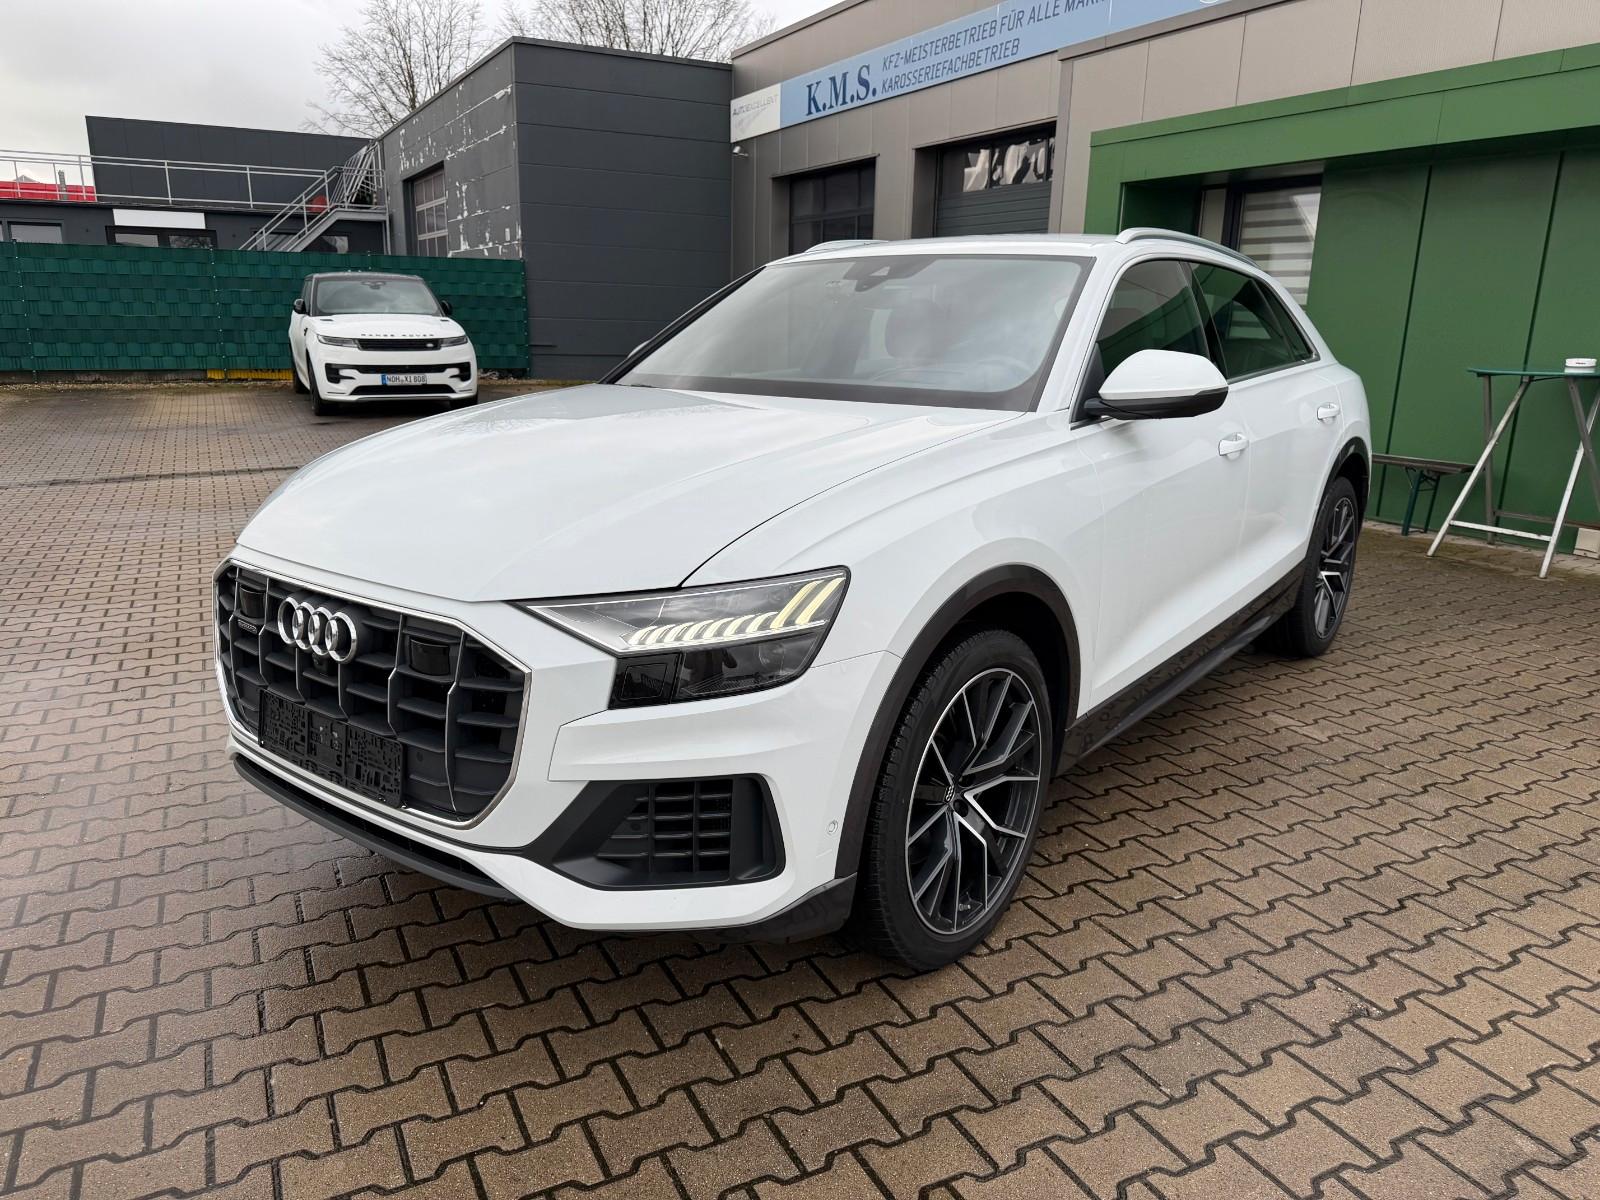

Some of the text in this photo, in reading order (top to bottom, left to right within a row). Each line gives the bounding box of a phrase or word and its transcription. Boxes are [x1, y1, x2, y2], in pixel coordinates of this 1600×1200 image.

[882, 19, 998, 72] KFZ-MEISTERBETRIEB
[1000, 9, 1025, 34] FÜR
[1027, 0, 1060, 25] ALLE
[806, 64, 877, 116] K.M.S.
[881, 38, 1020, 94] KAROSSERIEFACHBETRIEB
